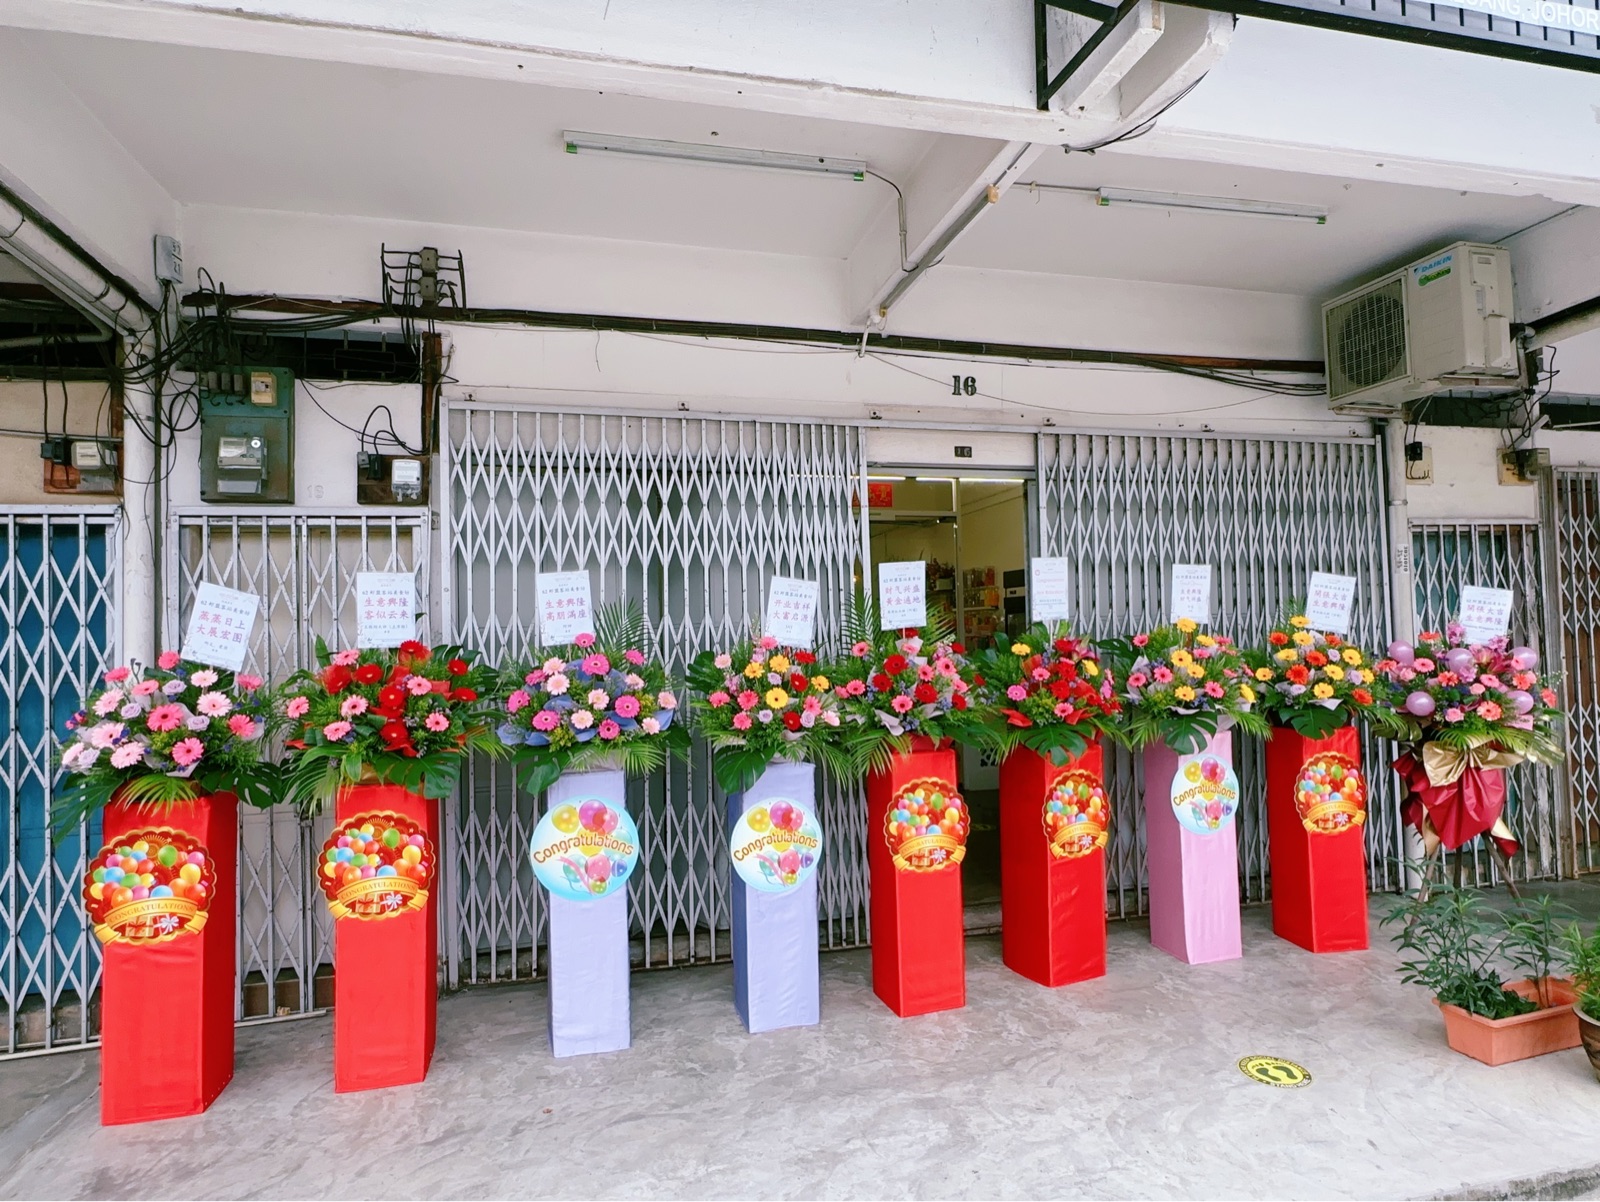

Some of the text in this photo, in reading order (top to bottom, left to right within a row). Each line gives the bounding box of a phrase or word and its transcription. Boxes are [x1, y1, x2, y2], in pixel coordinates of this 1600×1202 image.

[1532, 1, 1600, 31] JOHOR
[1421, 254, 1452, 272] DAIKIN
[952, 375, 977, 396] 16
[1173, 783, 1236, 806] Congratulations
[533, 833, 634, 864] Congratulations
[733, 831, 818, 861] Congratulations
[341, 882, 417, 900] CONGRATULATIONS
[109, 902, 195, 923] CONGRATULATIONS
